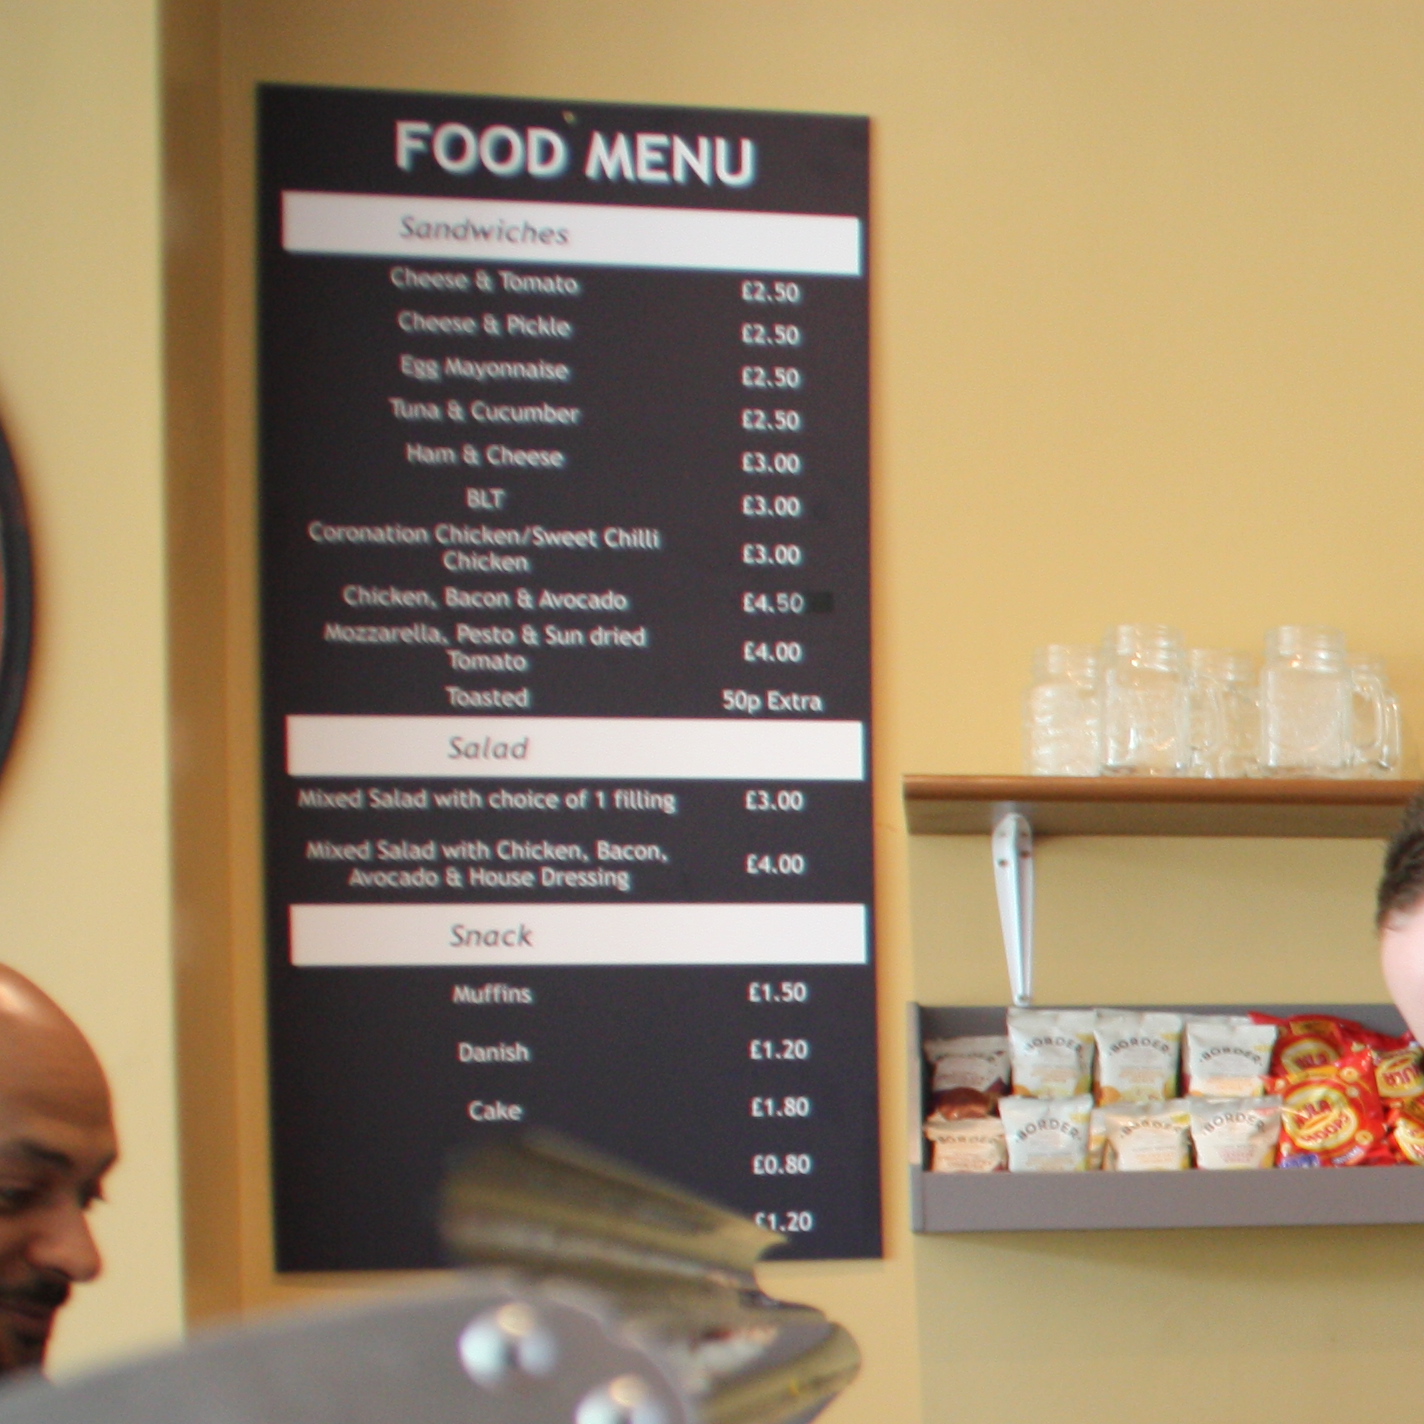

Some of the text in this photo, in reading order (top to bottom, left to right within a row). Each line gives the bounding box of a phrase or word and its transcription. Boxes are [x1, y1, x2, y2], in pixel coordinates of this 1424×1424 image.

[396, 121, 755, 187] FOOD MENU
[397, 213, 568, 245] Sandwiches
[390, 266, 581, 295] Cheese & Tomato
[741, 280, 801, 303] £2.50
[397, 311, 573, 338] Cheese & Pickle
[741, 323, 801, 346] £2.50
[400, 354, 571, 381] Egg Mayonnaise
[741, 366, 801, 389] £2.50
[389, 397, 581, 425] Tuna & Cucumber
[742, 409, 801, 431] £2.50
[406, 443, 565, 468] Ham & Cheese
[742, 452, 801, 474] £3.00
[466, 487, 506, 510] BLT
[742, 495, 802, 517] £3.00
[308, 521, 660, 550] Coronation Chicken/Sweet Chilli
[443, 550, 531, 573] Chicken
[742, 543, 802, 566] £3.00
[445, 586, 512, 609] Bacon
[516, 588, 534, 610] &
[538, 589, 629, 611] Avocado
[743, 592, 804, 614] £4.50
[456, 623, 517, 645] Pesto
[521, 624, 539, 646] &
[544, 624, 585, 646] Sun
[589, 625, 647, 647] dried
[447, 649, 529, 672] Tomato
[743, 641, 803, 663] £4.00
[445, 686, 531, 708] Toasted
[722, 689, 823, 715] 50p Extra
[447, 735, 529, 760] Salad
[298, 788, 677, 815] Mixed Salad with choice of 1 filling
[745, 789, 805, 811] £3.00
[306, 840, 373, 861] Mixed
[377, 839, 437, 861] Salad
[441, 840, 492, 861] with
[746, 853, 805, 875] £4.00
[349, 866, 631, 892] Avocado & House Dressing
[449, 923, 532, 948] Snack
[452, 983, 533, 1005] Muffins
[748, 981, 808, 1003] £1.50
[458, 1041, 530, 1063] Danish
[749, 1038, 809, 1060] £1.20
[1110, 1036, 1170, 1055] BORDER
[1201, 1046, 1262, 1063] BORDER
[468, 1100, 523, 1122] Cake
[751, 1096, 810, 1118] £1.80
[1017, 1118, 1080, 1142] BORDER
[1203, 1112, 1266, 1134] BORDER
[752, 1153, 812, 1175] £0.80
